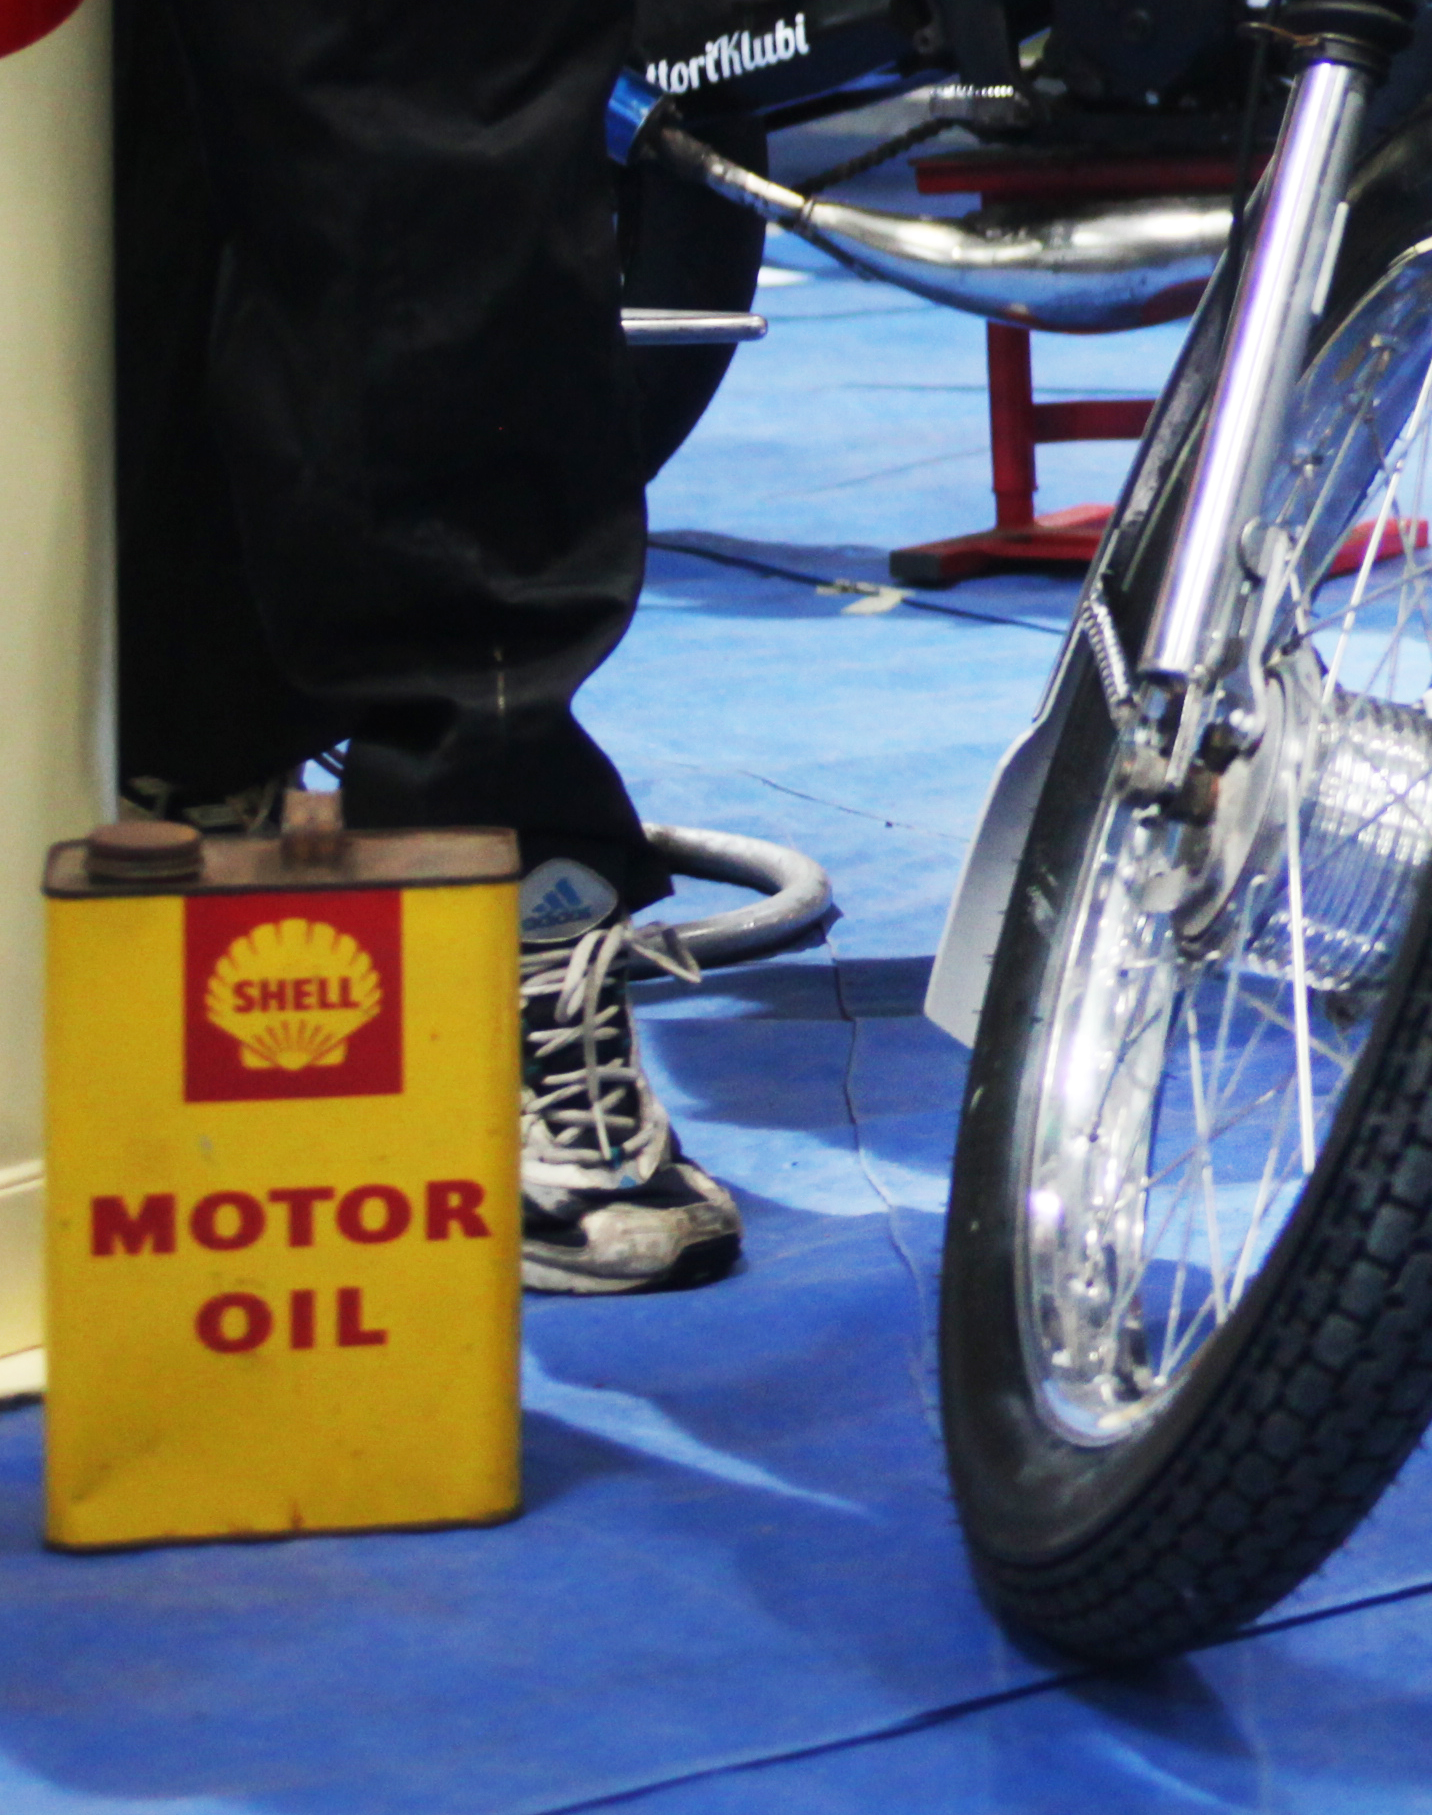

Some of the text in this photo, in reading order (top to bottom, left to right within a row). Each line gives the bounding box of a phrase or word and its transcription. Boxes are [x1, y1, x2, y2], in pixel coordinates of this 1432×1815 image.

[233, 975, 362, 1015] SHELL
[89, 1179, 492, 1258] MOTOR
[194, 1287, 388, 1354] OIL
